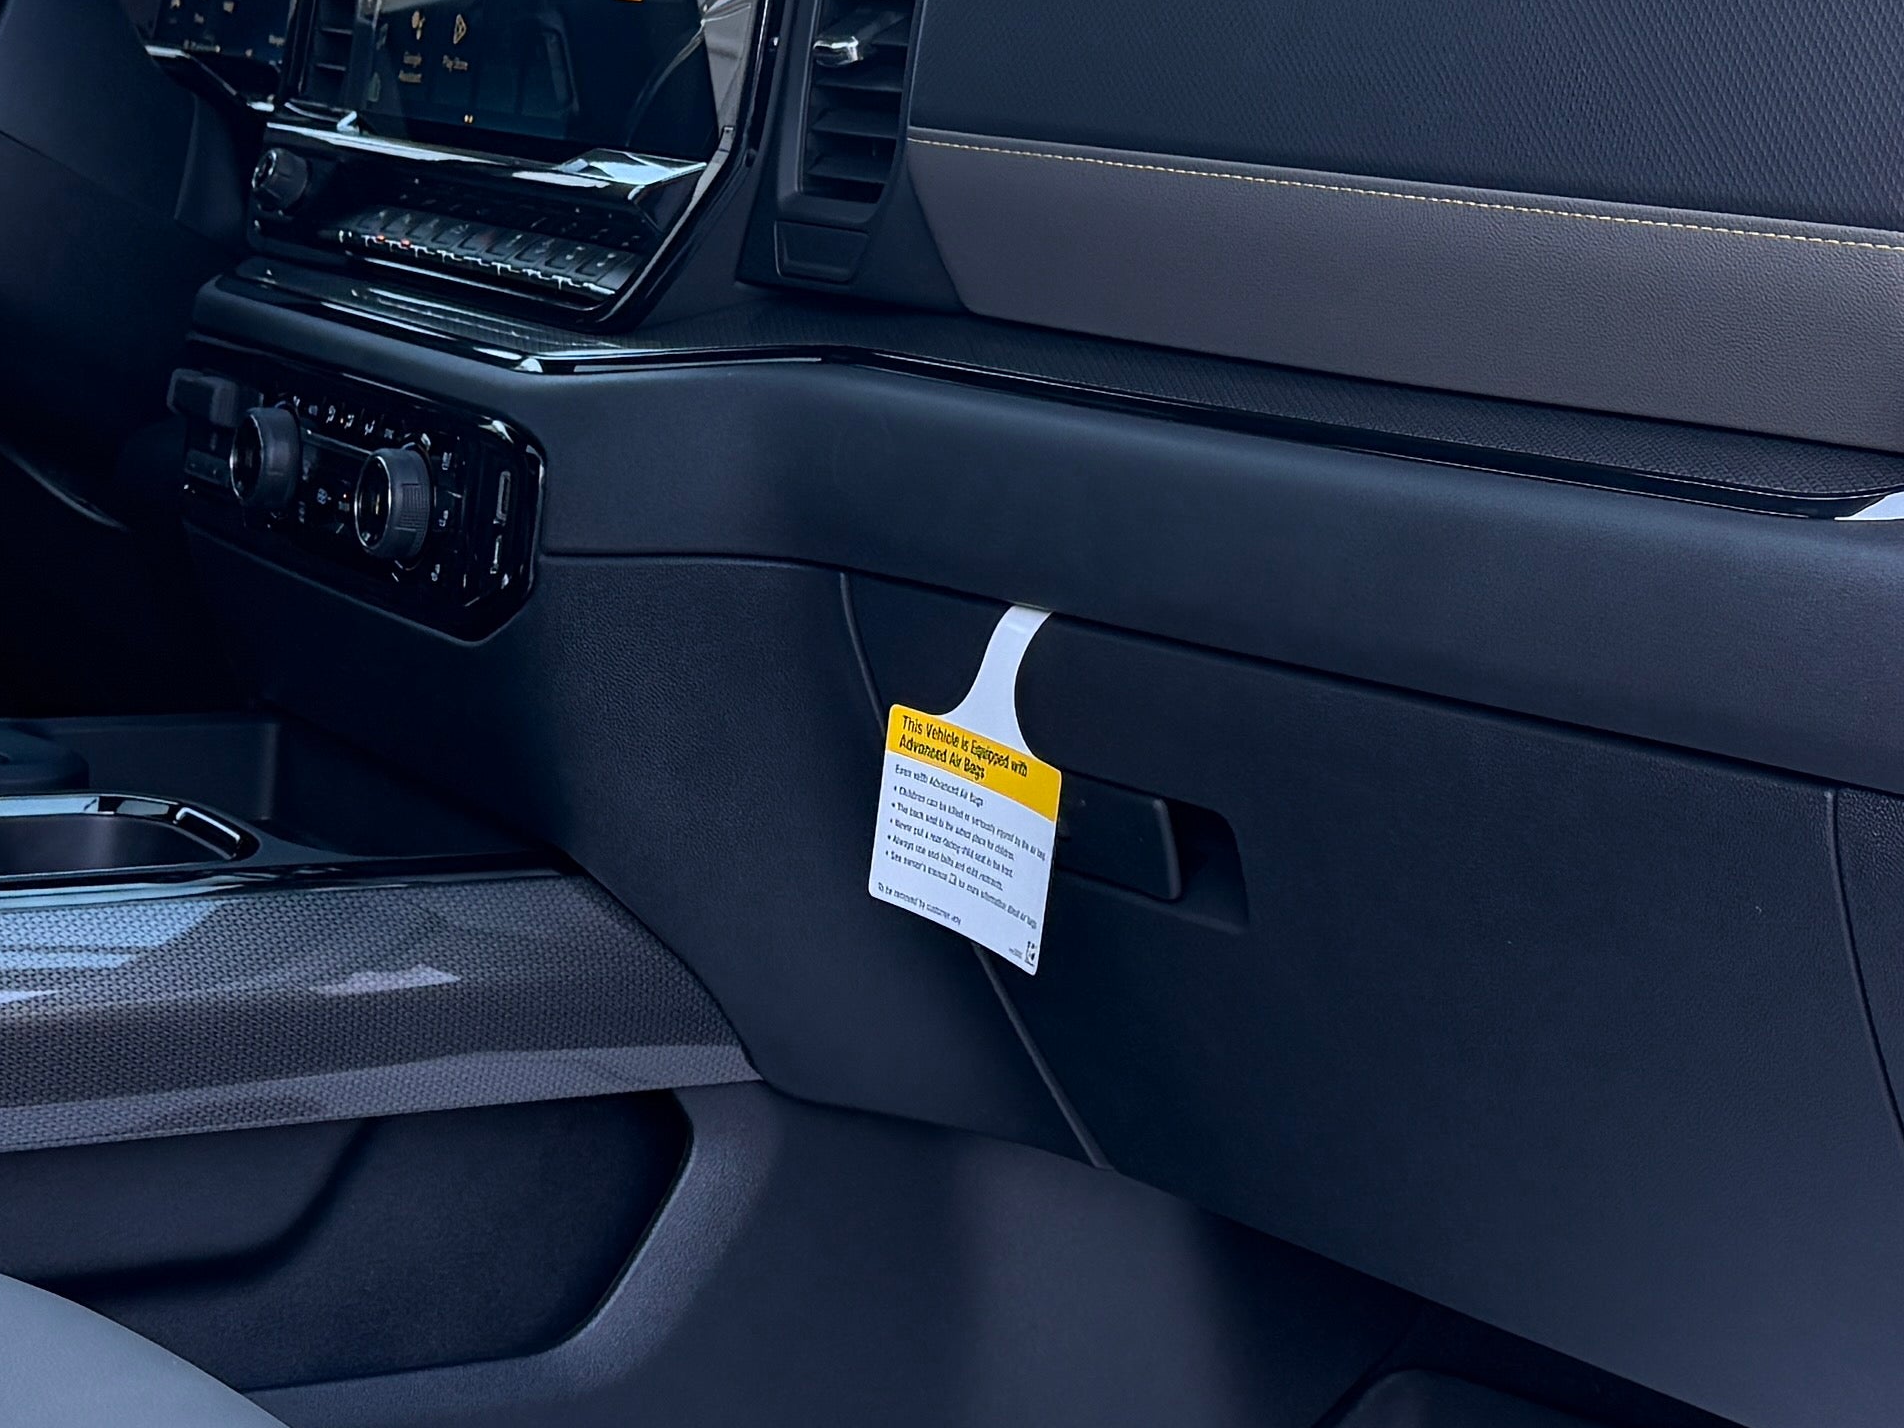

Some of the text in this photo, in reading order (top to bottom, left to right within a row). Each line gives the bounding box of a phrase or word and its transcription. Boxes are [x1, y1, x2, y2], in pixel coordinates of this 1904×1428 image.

[899, 733, 948, 764] Advanced
[948, 751, 963, 768] Air
[902, 714, 923, 736] This
[926, 722, 960, 748] Vehicle
[960, 736, 970, 753] is
[970, 739, 1010, 770] Equipped
